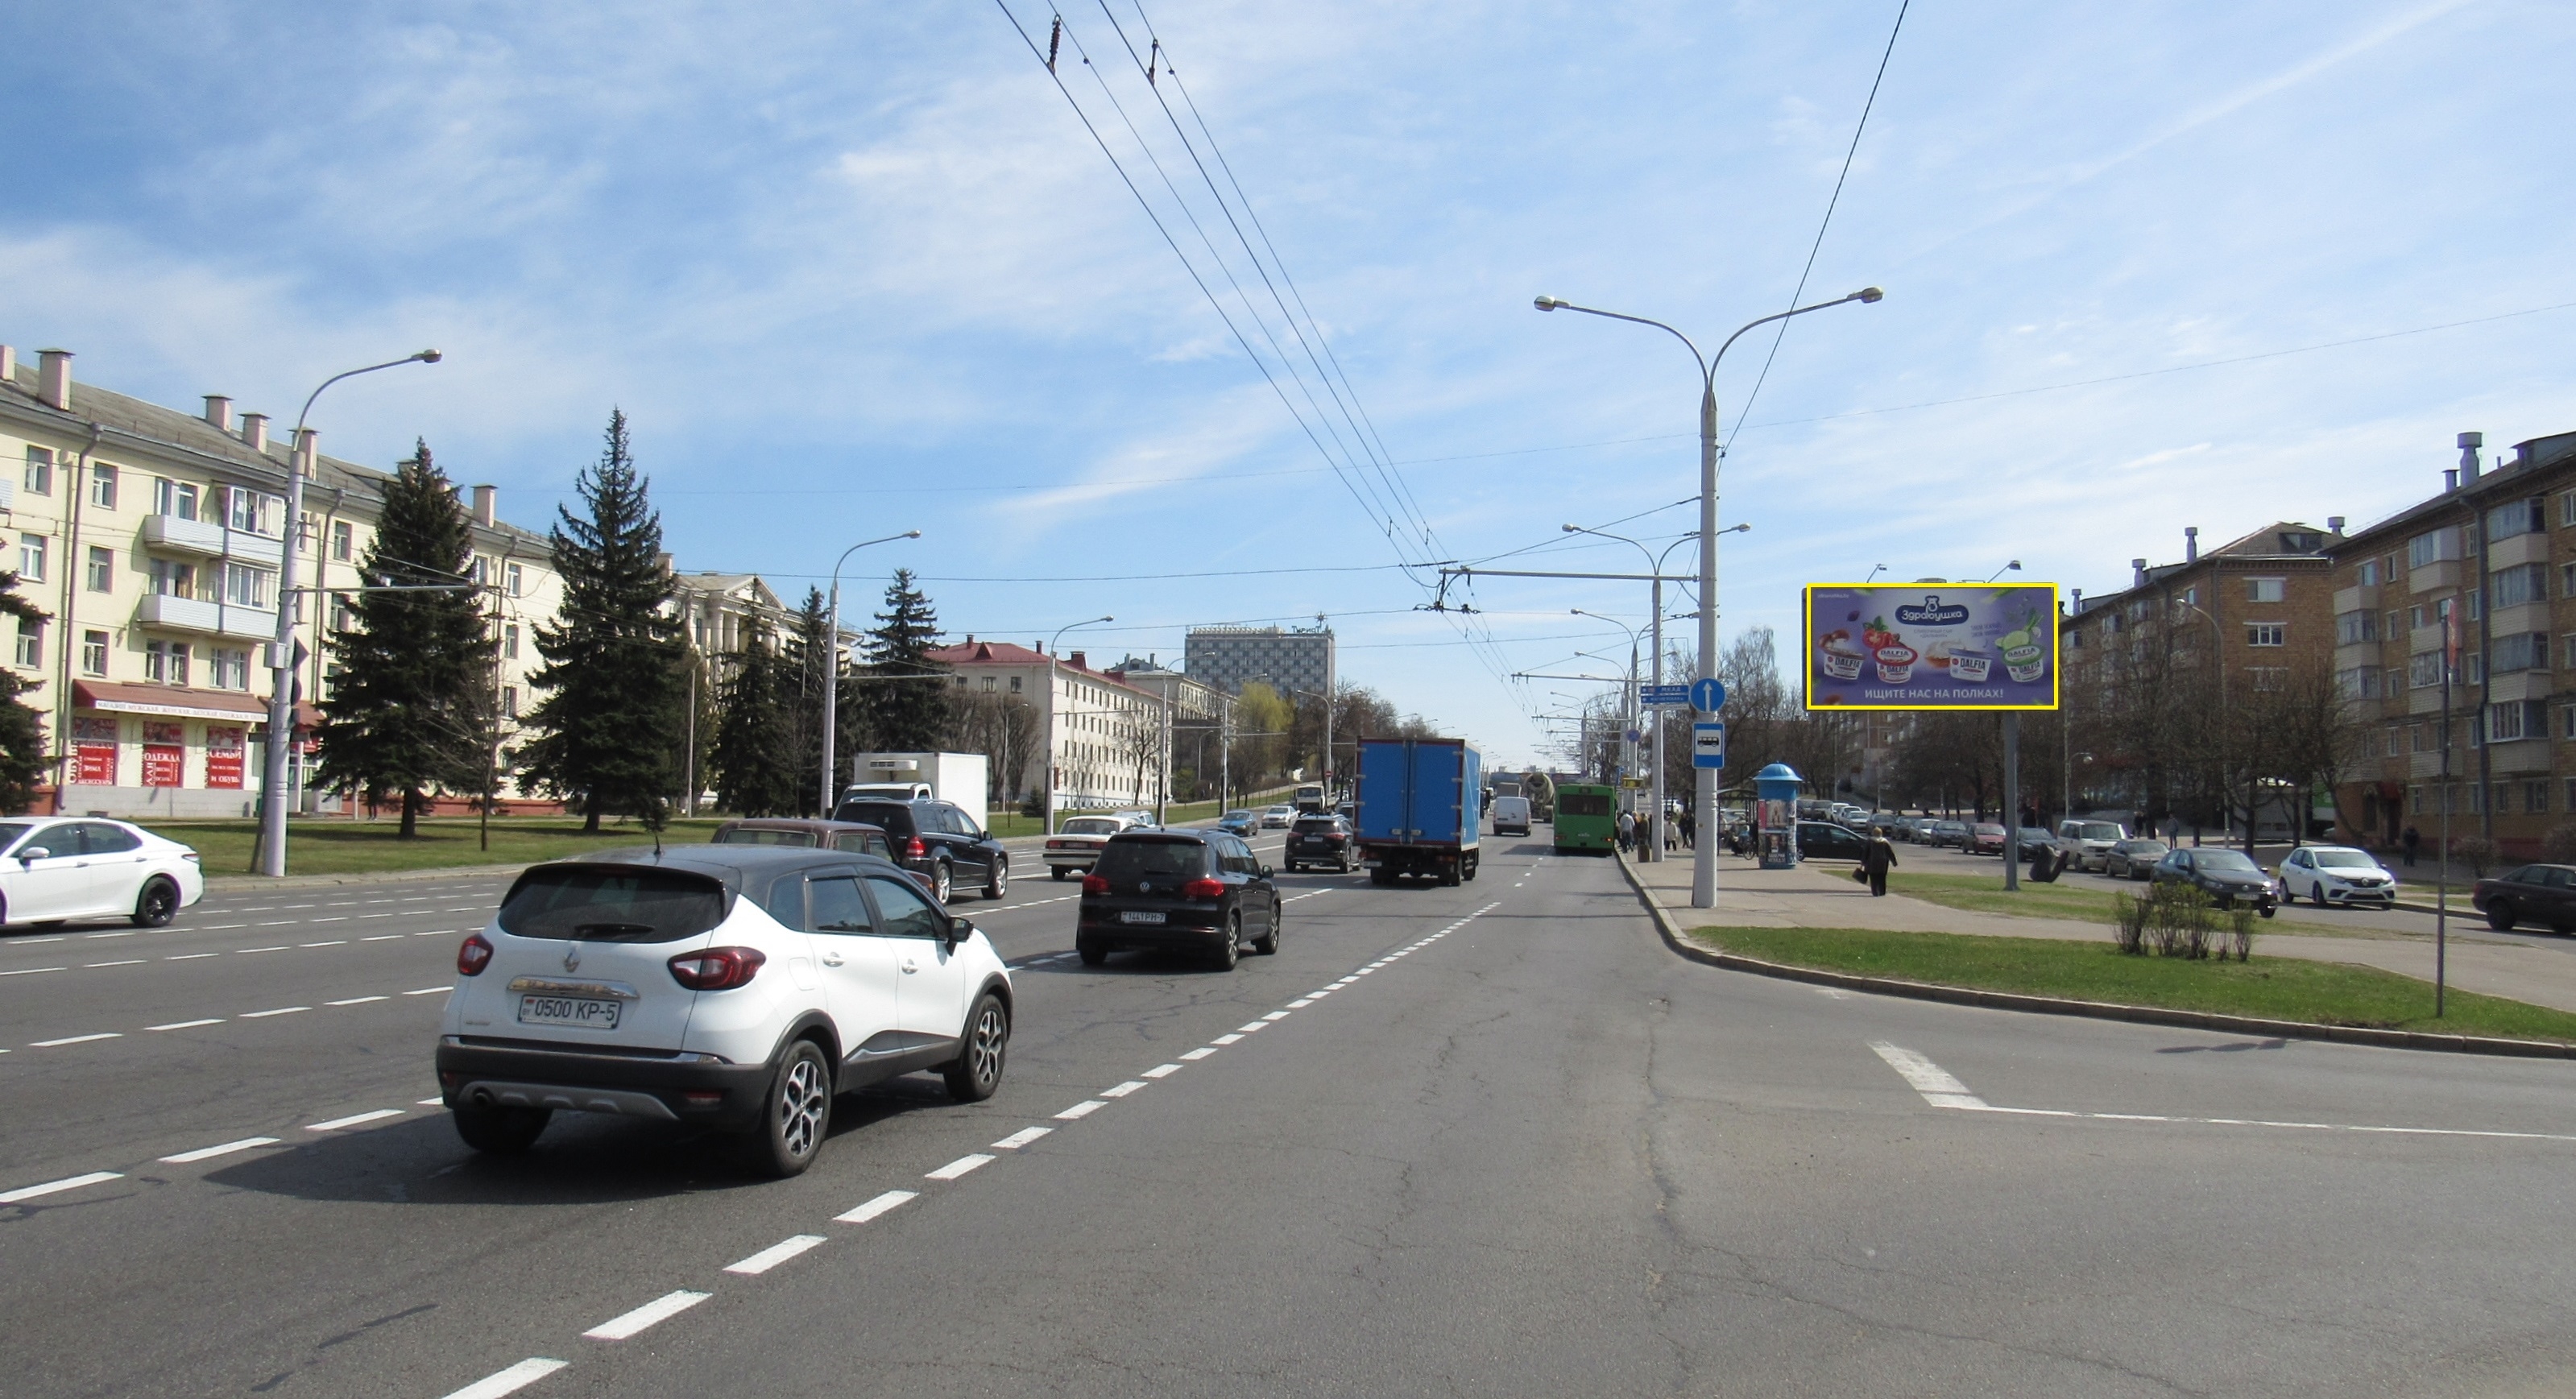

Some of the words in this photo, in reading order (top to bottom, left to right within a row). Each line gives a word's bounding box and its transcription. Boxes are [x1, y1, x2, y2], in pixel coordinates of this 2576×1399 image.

[1901, 609, 1963, 622] Здравушка
[2007, 647, 2036, 656] DALFIA
[1835, 656, 1861, 668] DALFIA
[1959, 658, 1986, 670] DALFIA
[2019, 661, 2040, 673] DALFIA
[1886, 664, 1909, 673] DALFIA
[1865, 689, 1906, 700] ИЩИТЕ
[1908, 689, 1932, 698] НАС
[1933, 689, 1949, 698] НА
[1953, 689, 2003, 698] ПОЛКАХ!
[535, 999, 572, 1018] 0500
[575, 1001, 617, 1021] KP-5
